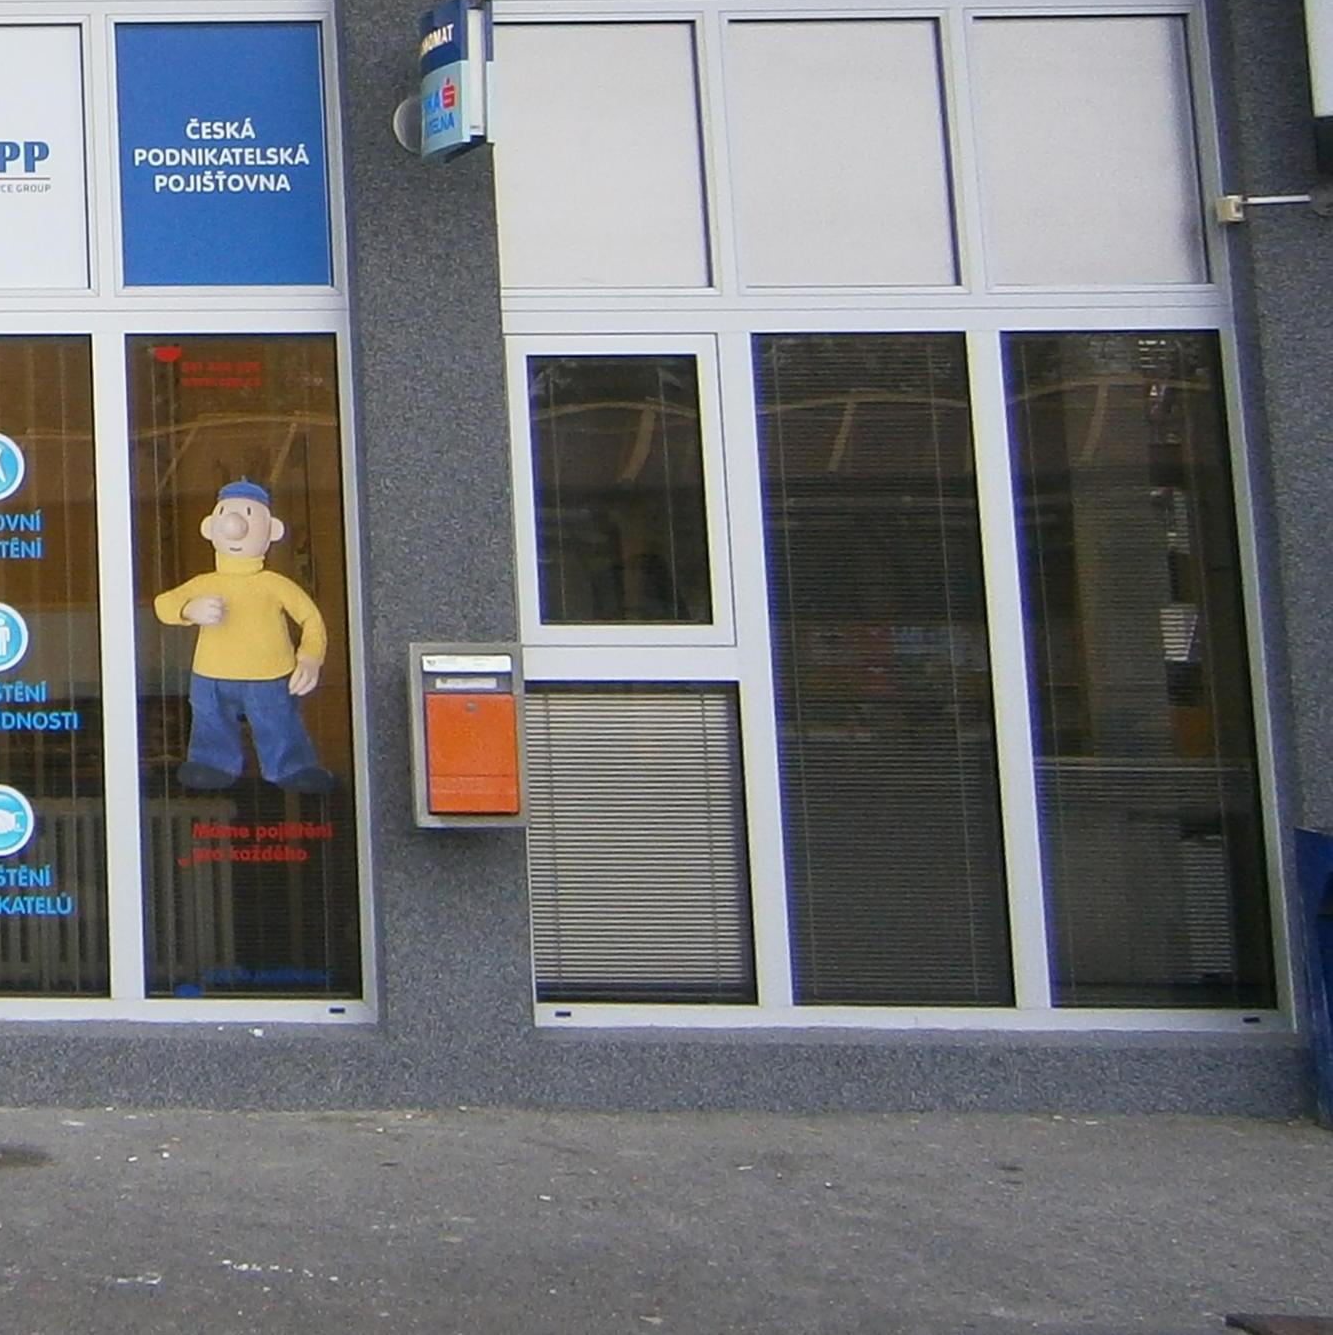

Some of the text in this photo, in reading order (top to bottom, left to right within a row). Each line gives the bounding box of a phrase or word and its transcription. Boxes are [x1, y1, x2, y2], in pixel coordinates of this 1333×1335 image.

[186, 117, 256, 139] ČESKÁ
[134, 143, 310, 166] PODNIKATELSKÁ
[16, 184, 51, 193] GROUP
[154, 170, 291, 193] POJIŠŤOVNA
